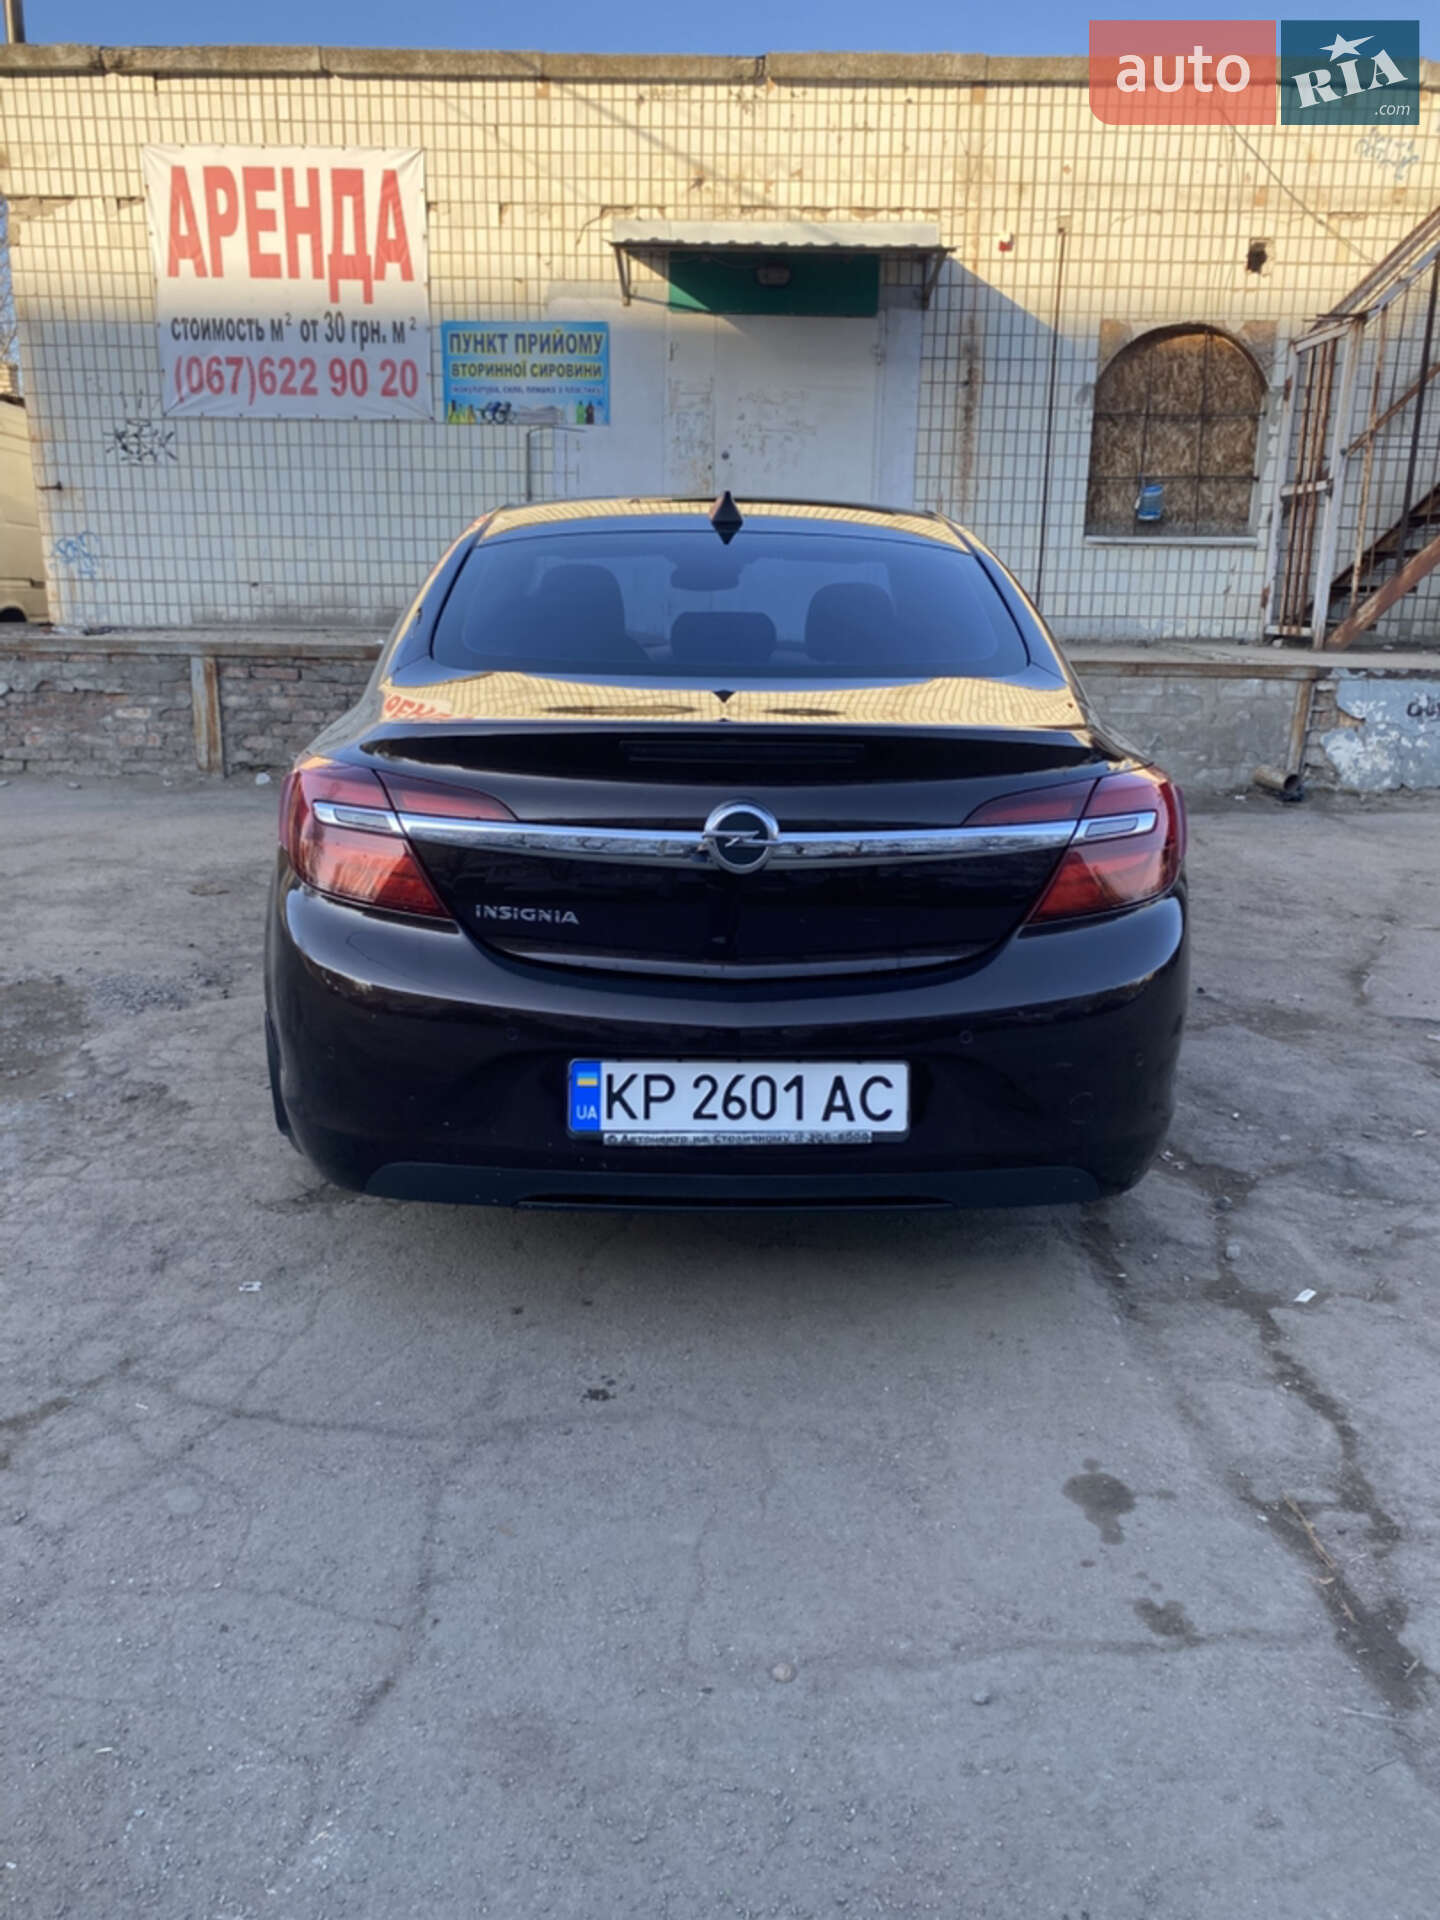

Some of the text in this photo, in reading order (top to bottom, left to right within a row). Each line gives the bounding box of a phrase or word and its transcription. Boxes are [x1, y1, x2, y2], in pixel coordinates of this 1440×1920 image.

[167, 165, 414, 304] АРЕНДА
[300, 320, 319, 342] от
[324, 311, 346, 343] 30
[351, 319, 388, 351] грн.
[449, 328, 604, 355] ПУНКТ ПРИЙОМУ
[175, 355, 419, 405] (067)622 90 20
[451, 360, 603, 378] ВТОРИННОЇ СИРОВИНИ
[475, 904, 580, 925] INSIGNIA
[576, 1105, 598, 1120] UA
[606, 1073, 895, 1122] KP 2601 AC
